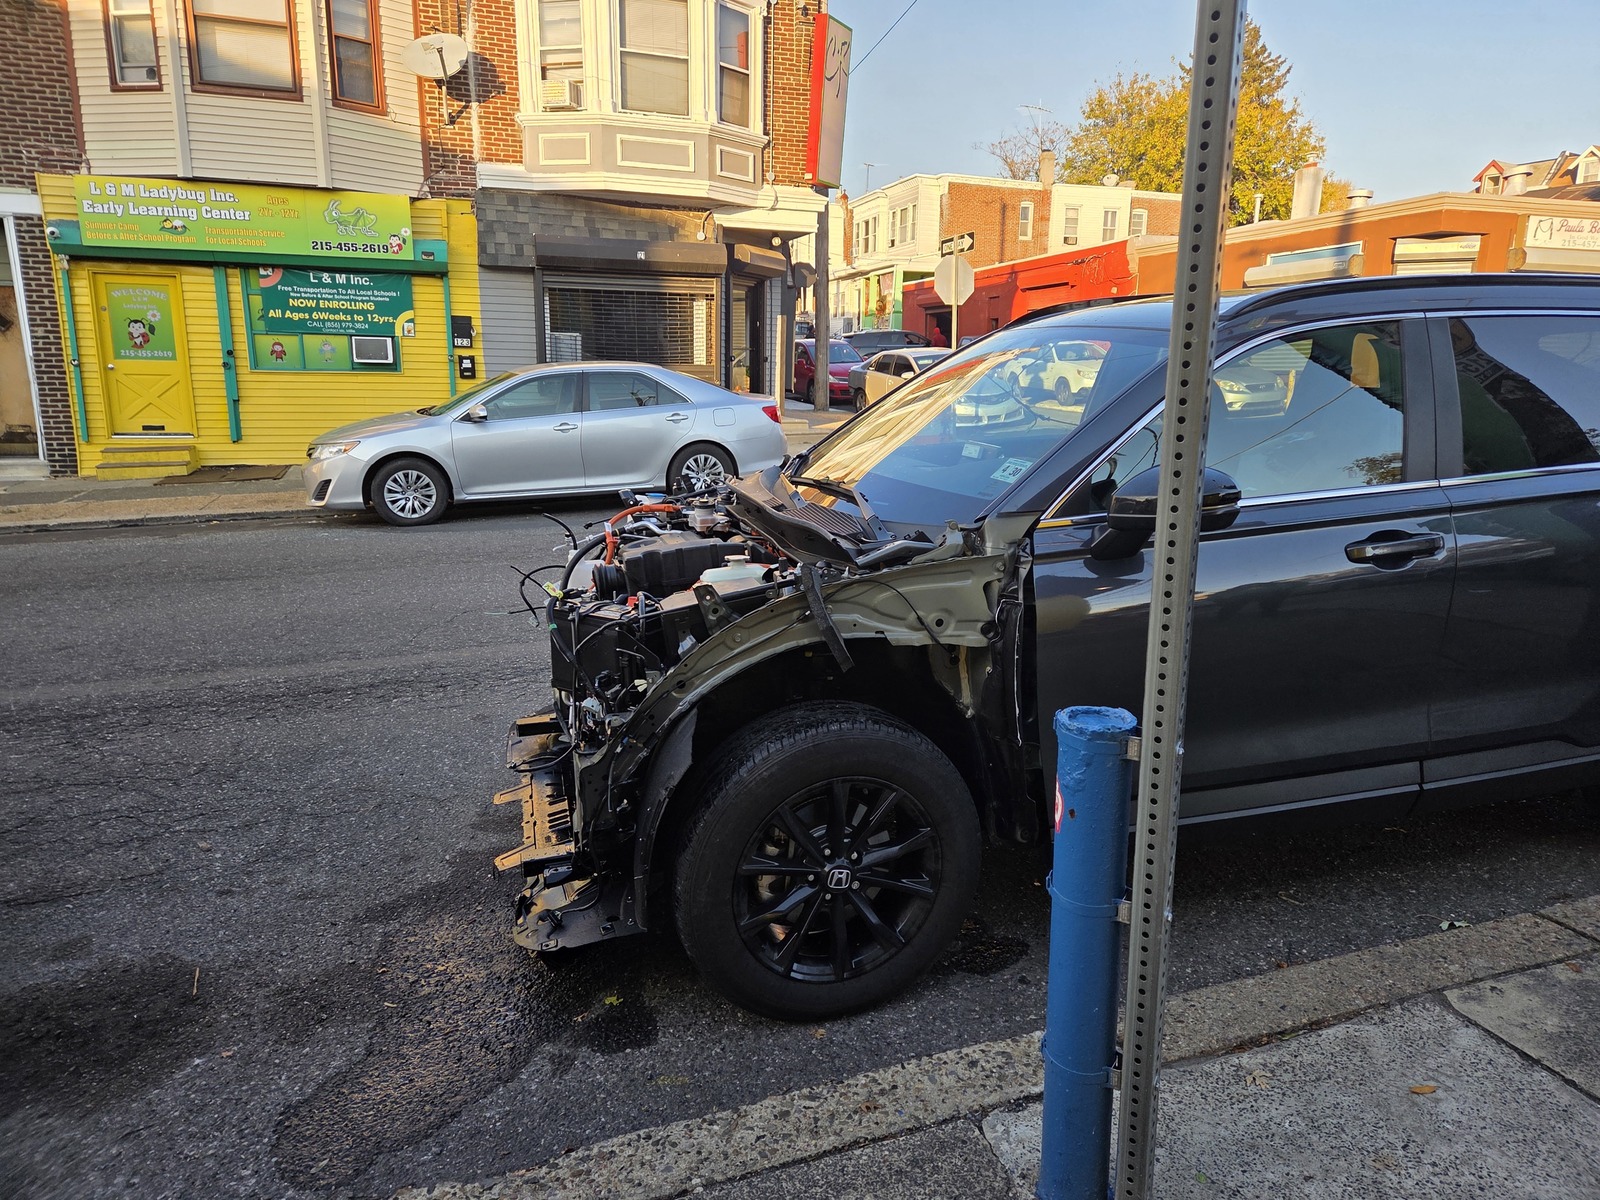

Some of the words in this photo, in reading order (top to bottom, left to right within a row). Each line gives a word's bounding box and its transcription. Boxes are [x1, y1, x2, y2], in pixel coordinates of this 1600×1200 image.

[89, 181, 101, 195] L
[104, 182, 117, 196] &
[120, 183, 135, 197] M
[139, 184, 206, 203] Ladybug
[209, 188, 239, 203] Inc.
[266, 194, 290, 206] Ages
[82, 199, 125, 217] Early
[128, 202, 199, 221] Learning
[201, 205, 251, 221] Center
[84, 220, 117, 231] Summer
[118, 222, 140, 232] Camp
[1557, 218, 1585, 233] Paula
[86, 231, 112, 240] Before
[120, 232, 138, 241] After
[139, 233, 165, 242] School
[165, 234, 197, 245] Program
[204, 226, 258, 238] Transportation
[259, 229, 286, 238] Service
[206, 236, 217, 244] For
[218, 236, 238, 246] Local
[238, 238, 267, 247] Schools
[311, 240, 390, 254] 215-455-2619
[944, 242, 953, 252] ONE
[310, 272, 318, 283] L
[322, 273, 332, 284] &
[336, 274, 346, 285] M
[350, 275, 374, 286] Inc.
[111, 288, 168, 301] WELCOME
[294, 286, 338, 294] Transportation
[289, 299, 317, 308] NOW
[319, 300, 375, 311] ENROLLING
[268, 309, 282, 319] All
[285, 310, 310, 321] Ages
[312, 311, 352, 321] 6Weeks
[353, 313, 364, 322] to
[367, 314, 396, 325] 12yrs.
[307, 320, 324, 328] CALL
[341, 322, 369, 330] 979-3824
[455, 338, 470, 346] 123
